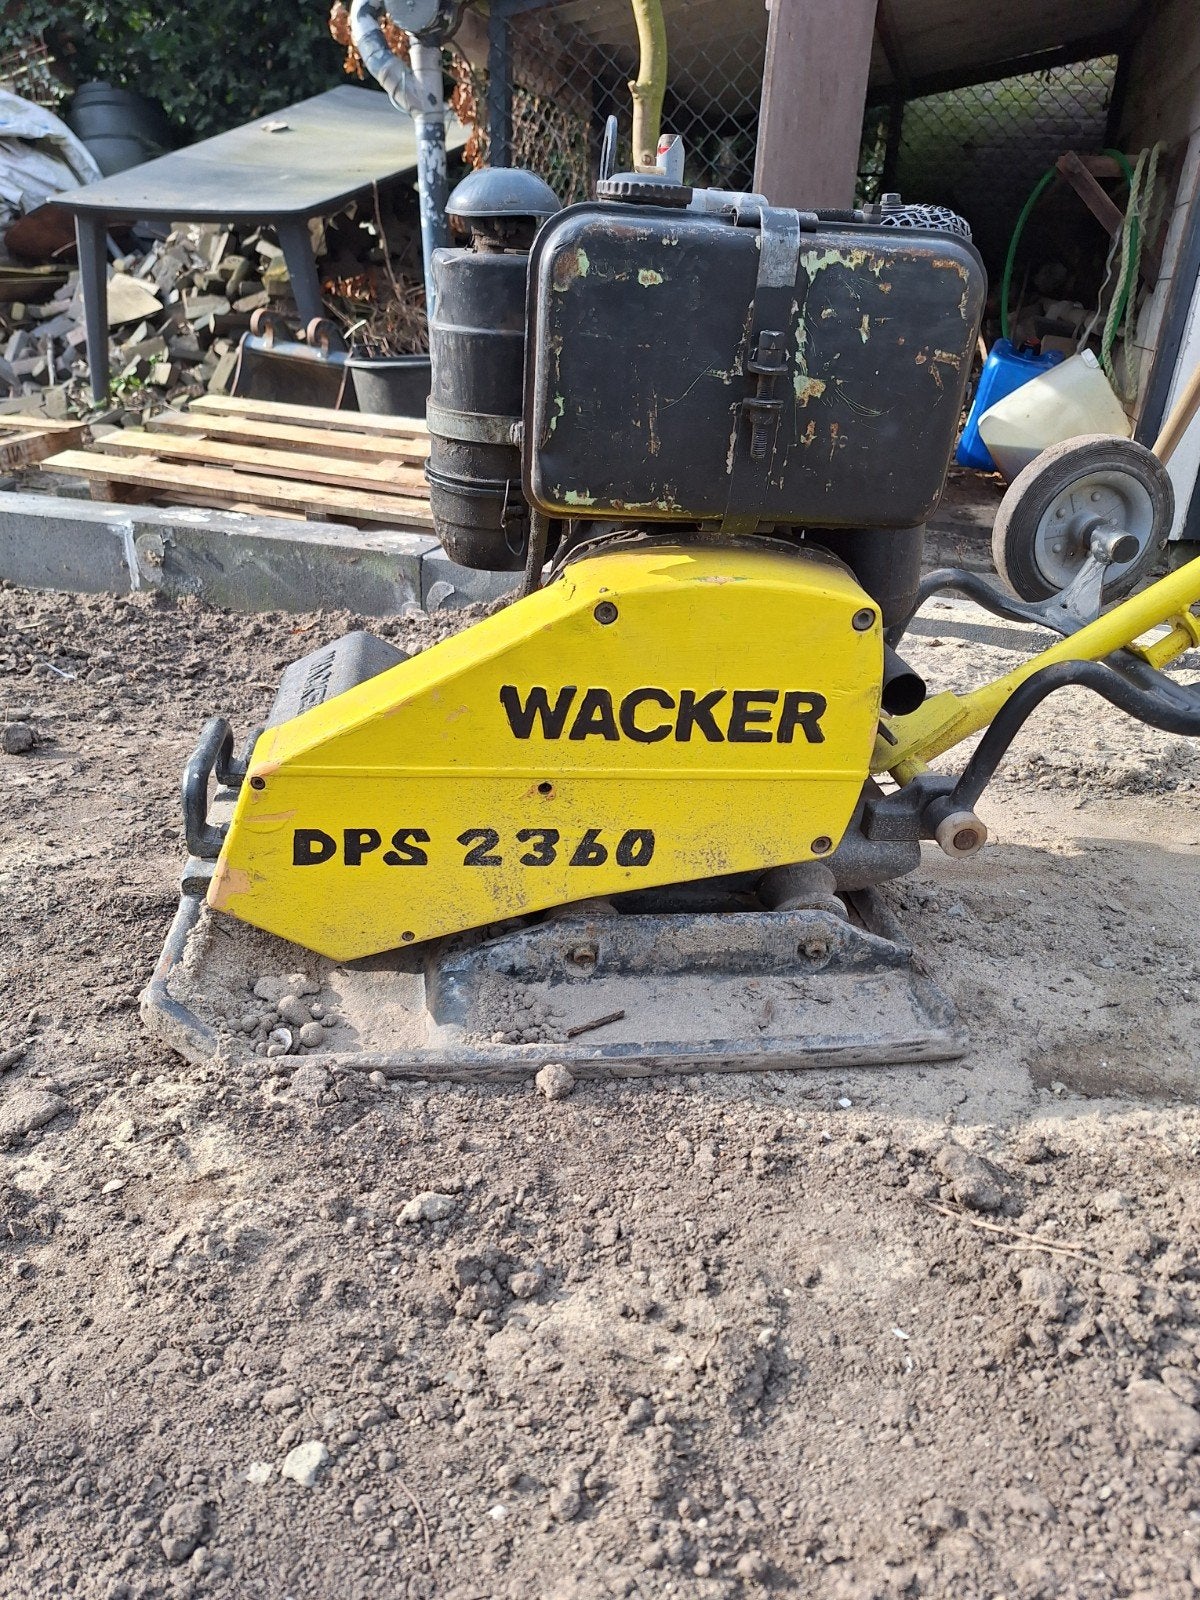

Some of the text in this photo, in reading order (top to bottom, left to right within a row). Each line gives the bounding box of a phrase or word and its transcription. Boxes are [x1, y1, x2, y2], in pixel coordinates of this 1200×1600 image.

[499, 686, 827, 743] WACKER
[293, 829, 655, 866] DPS 2360
